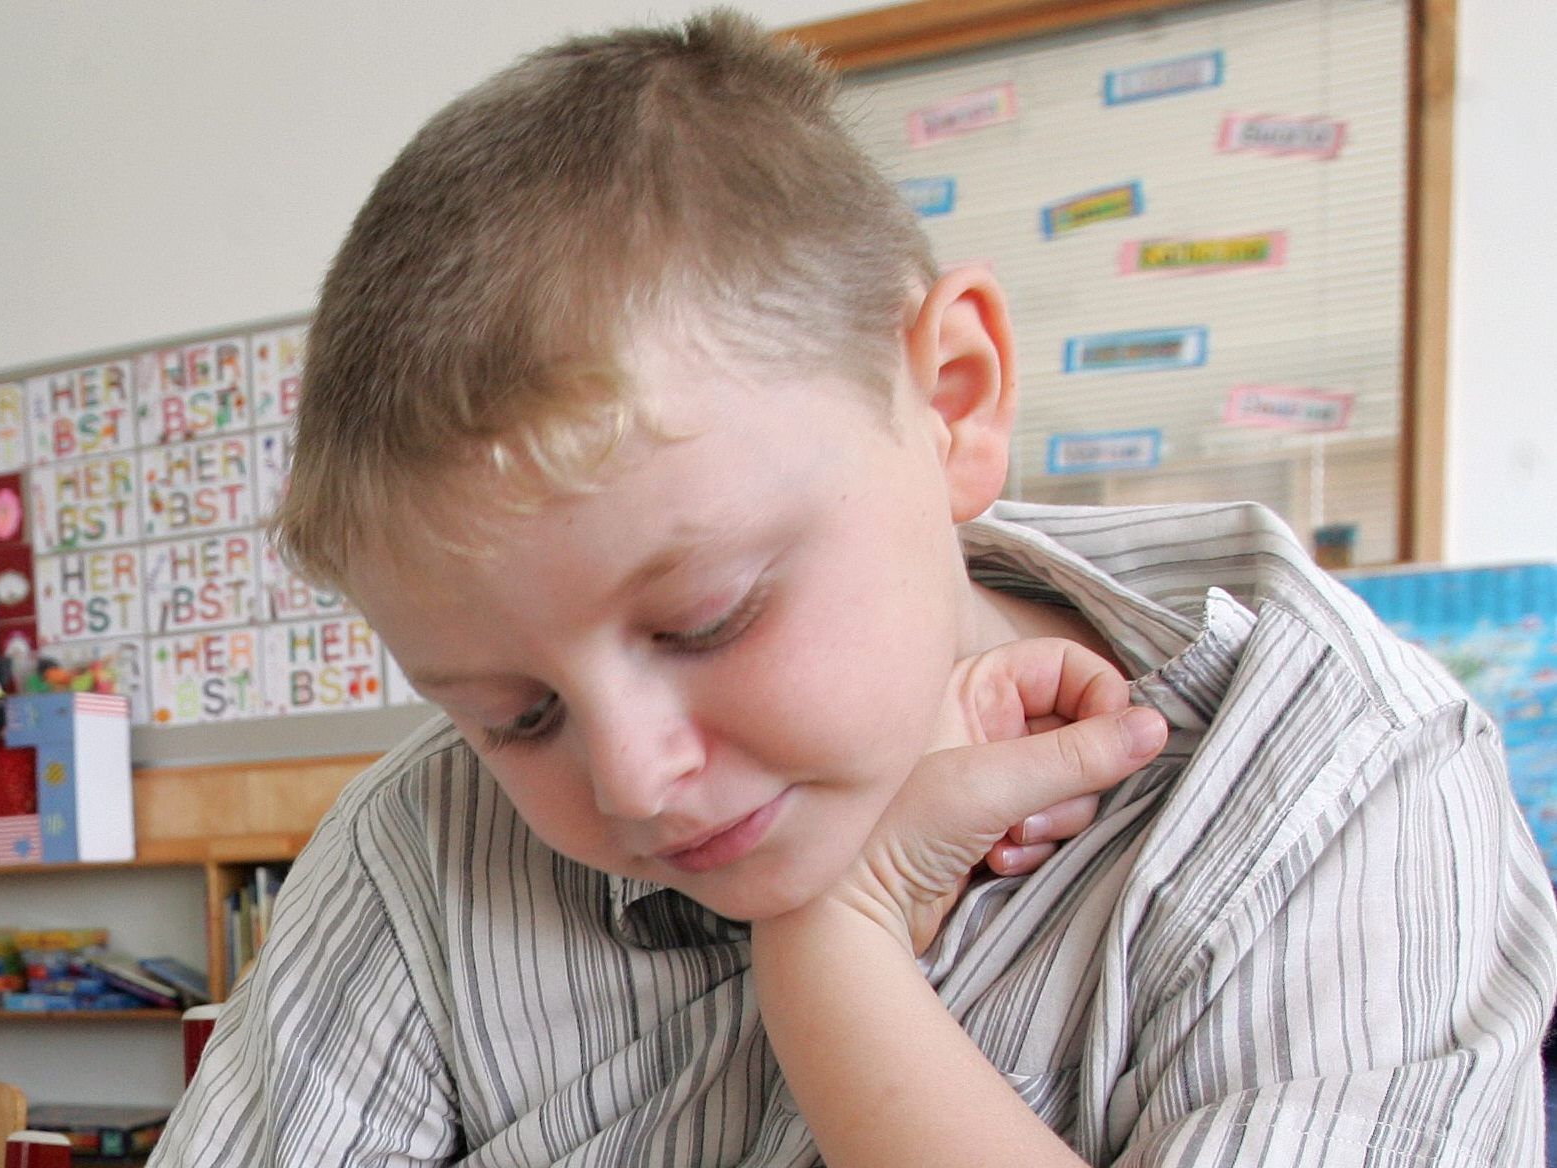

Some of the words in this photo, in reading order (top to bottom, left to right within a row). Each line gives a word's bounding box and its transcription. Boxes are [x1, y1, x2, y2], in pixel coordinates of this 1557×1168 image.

[49, 366, 127, 413] HER
[157, 342, 241, 392] HER
[52, 409, 125, 459] BST
[162, 388, 240, 438] BST
[55, 459, 133, 501] HER
[165, 436, 246, 484] HER
[56, 502, 126, 546] BST
[165, 483, 245, 528] BST
[61, 552, 137, 596] HER
[170, 537, 250, 582] HER
[62, 593, 134, 636] BST
[172, 579, 246, 625] BST
[174, 632, 255, 675] HER
[289, 619, 374, 664] HER
[177, 667, 250, 720] BST
[290, 664, 370, 707] BST
